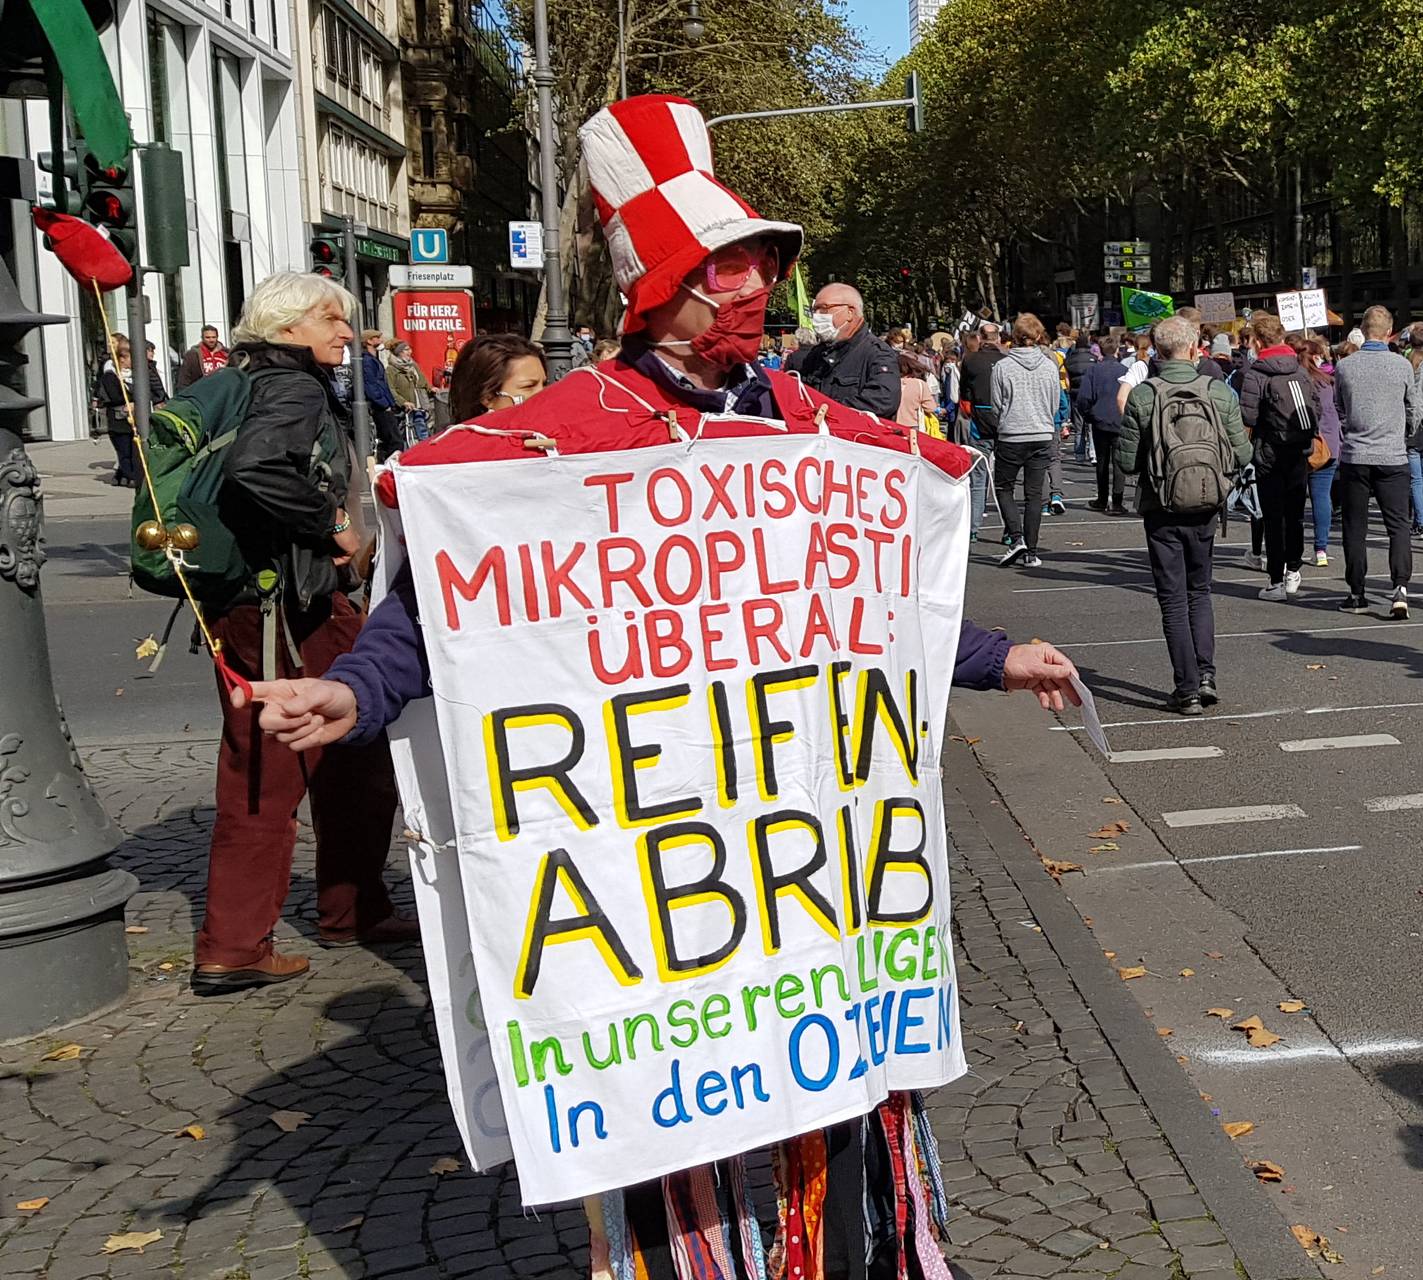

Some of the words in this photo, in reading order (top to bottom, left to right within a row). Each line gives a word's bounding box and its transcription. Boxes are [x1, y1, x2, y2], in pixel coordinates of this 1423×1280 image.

[418, 234, 440, 258] U
[407, 272, 455, 282] Friesenplatz
[403, 319, 426, 331] UND
[428, 319, 466, 331] KEHLE.
[407, 303, 428, 317] FÜR
[430, 305, 458, 317] HERZ
[583, 457, 908, 528] TOXISCHES
[436, 521, 921, 632] MIKROPLASTI
[506, 1019, 574, 1087] In
[581, 964, 851, 1070] unseren
[544, 1084, 607, 1153] In
[652, 1060, 770, 1128] den
